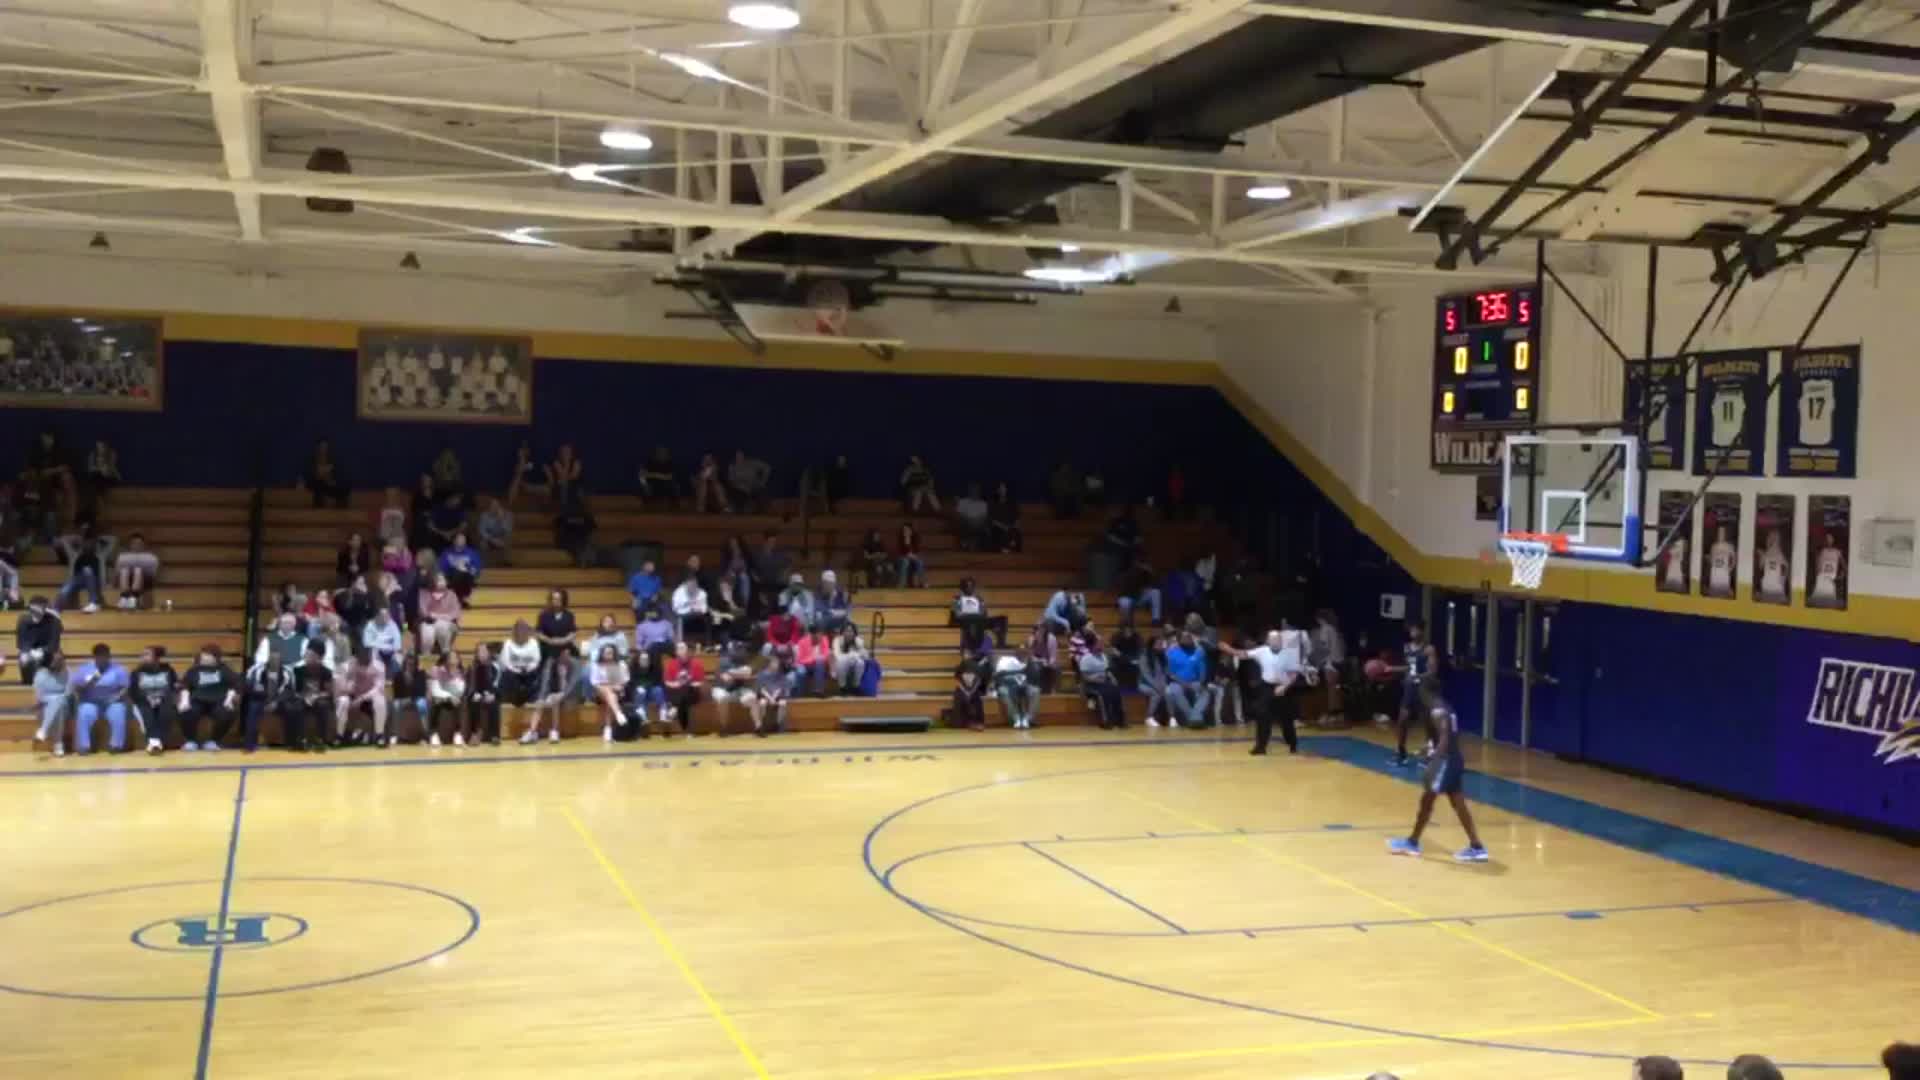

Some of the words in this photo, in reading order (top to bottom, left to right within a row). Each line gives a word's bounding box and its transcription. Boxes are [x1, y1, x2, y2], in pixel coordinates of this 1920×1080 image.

[1518, 300, 1530, 323] 5
[1454, 346, 1468, 375] 0
[1514, 341, 1530, 371] 0
[1722, 400, 1734, 423] 11
[1808, 396, 1826, 421] 17
